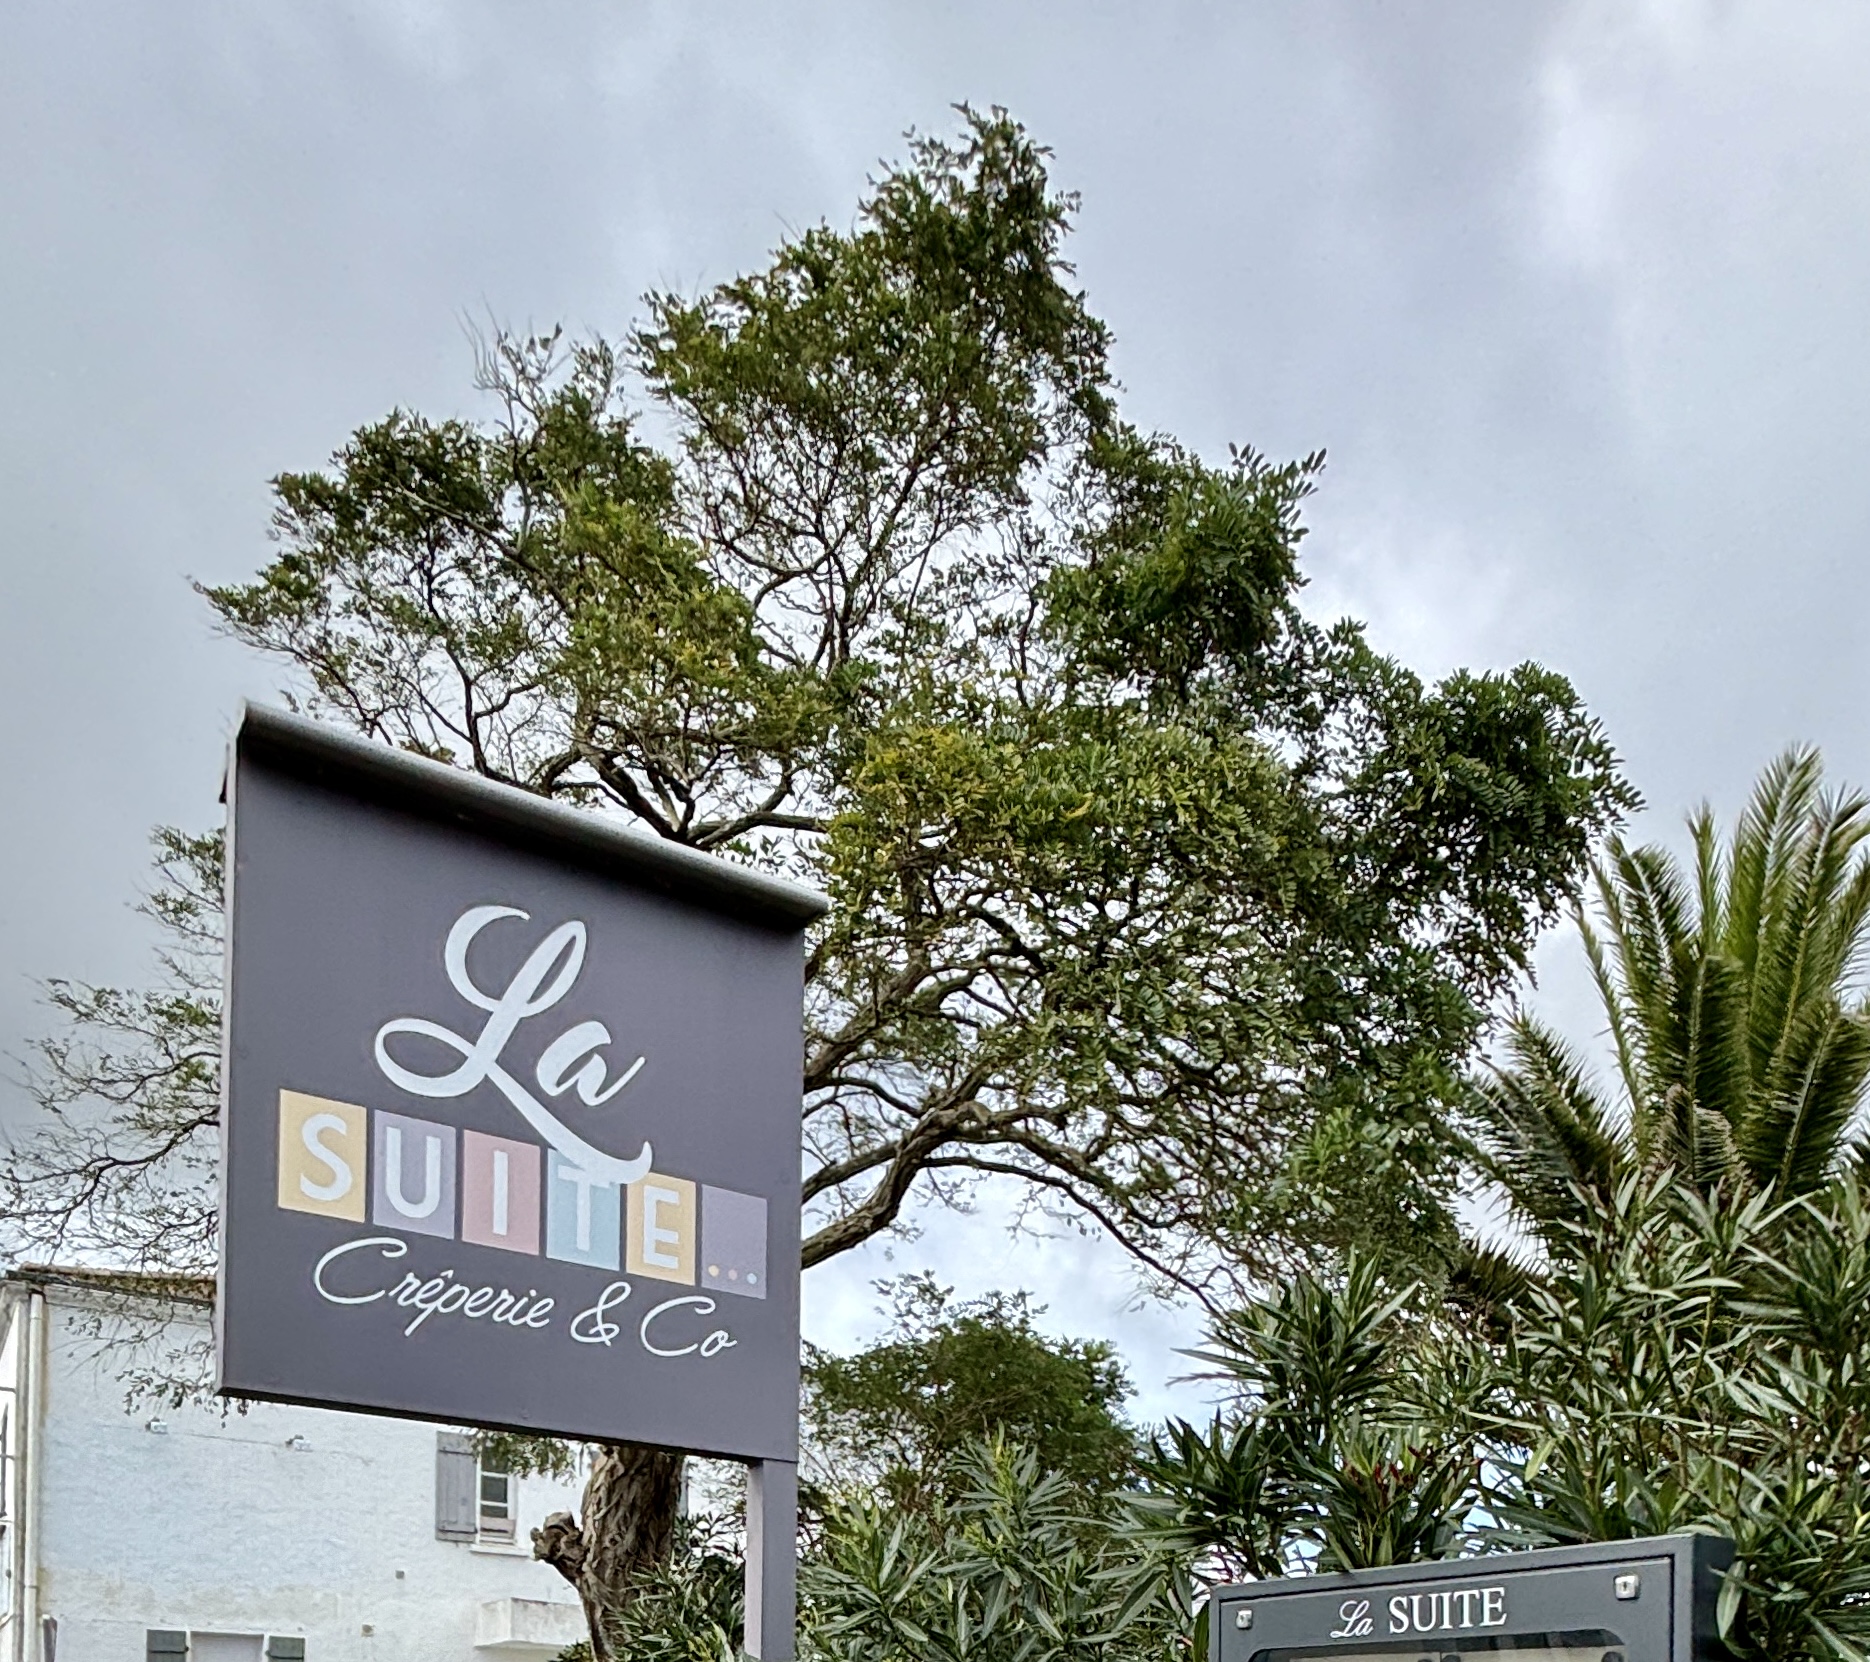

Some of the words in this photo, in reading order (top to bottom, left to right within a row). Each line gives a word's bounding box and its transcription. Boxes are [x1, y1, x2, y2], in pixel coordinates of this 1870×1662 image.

[374, 903, 653, 1185] La
[313, 1236, 553, 1337] Crêperie
[569, 1281, 632, 1347] &
[640, 1296, 737, 1358] Co
[1329, 1600, 1374, 1639] La
[1388, 1587, 1508, 1634] SUITE
